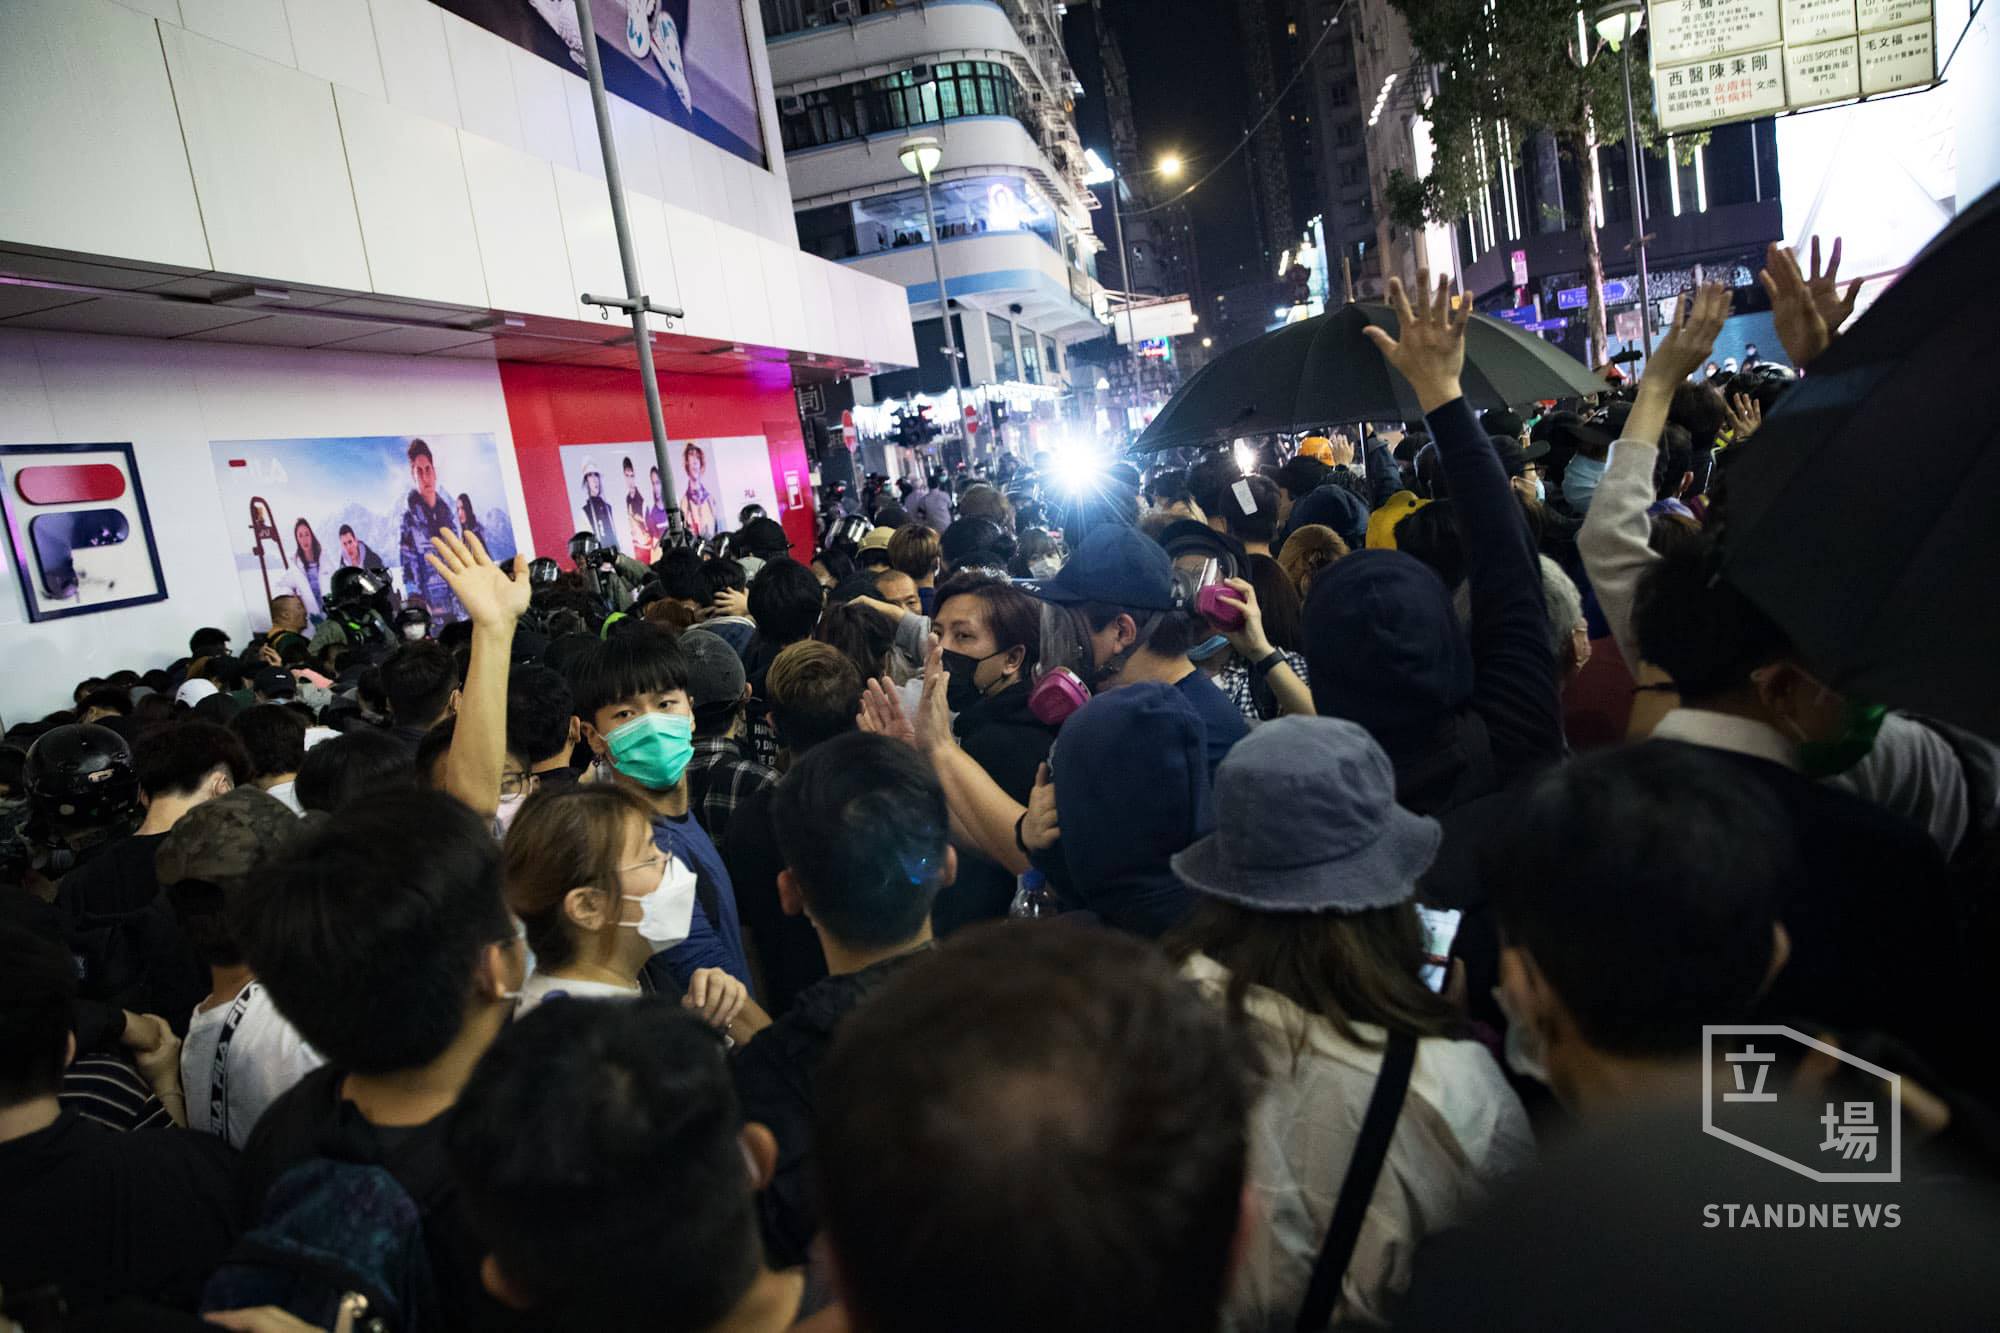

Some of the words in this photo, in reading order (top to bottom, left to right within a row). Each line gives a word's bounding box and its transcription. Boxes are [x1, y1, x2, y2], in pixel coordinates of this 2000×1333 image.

[1815, 48, 1838, 61] SPORT
[1839, 46, 1854, 56] NET
[1668, 54, 1768, 87] 西醫陳秉剛
